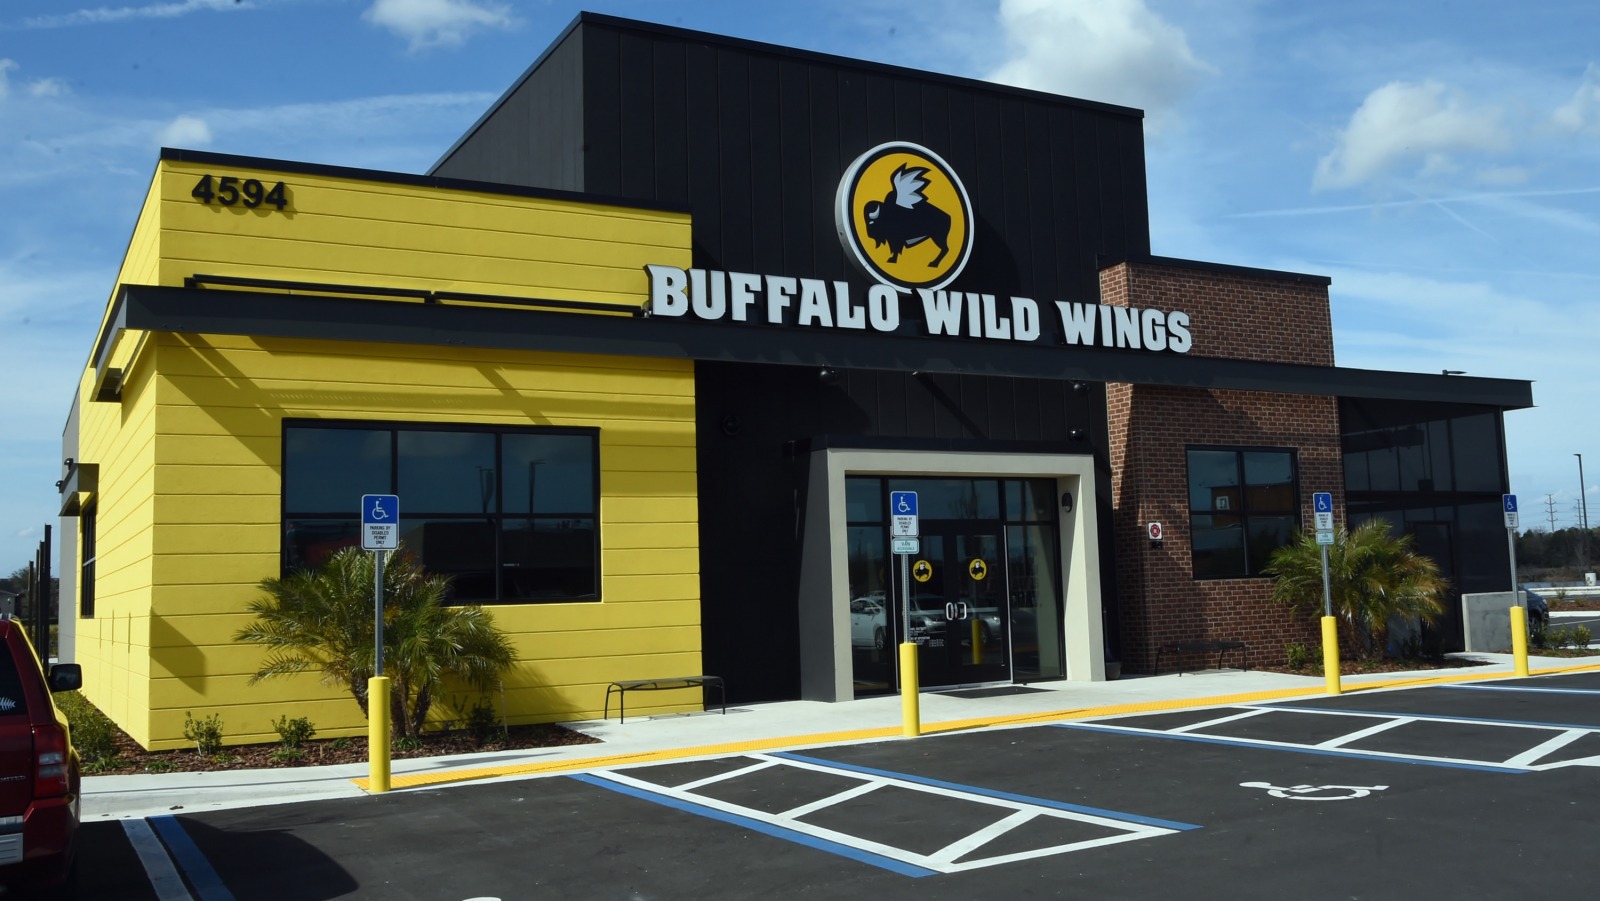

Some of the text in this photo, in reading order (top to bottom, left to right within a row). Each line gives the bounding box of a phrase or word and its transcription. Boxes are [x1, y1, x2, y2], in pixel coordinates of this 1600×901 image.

[192, 174, 287, 210] 4594
[646, 264, 1192, 353] BUFFALO WILD WINGS
